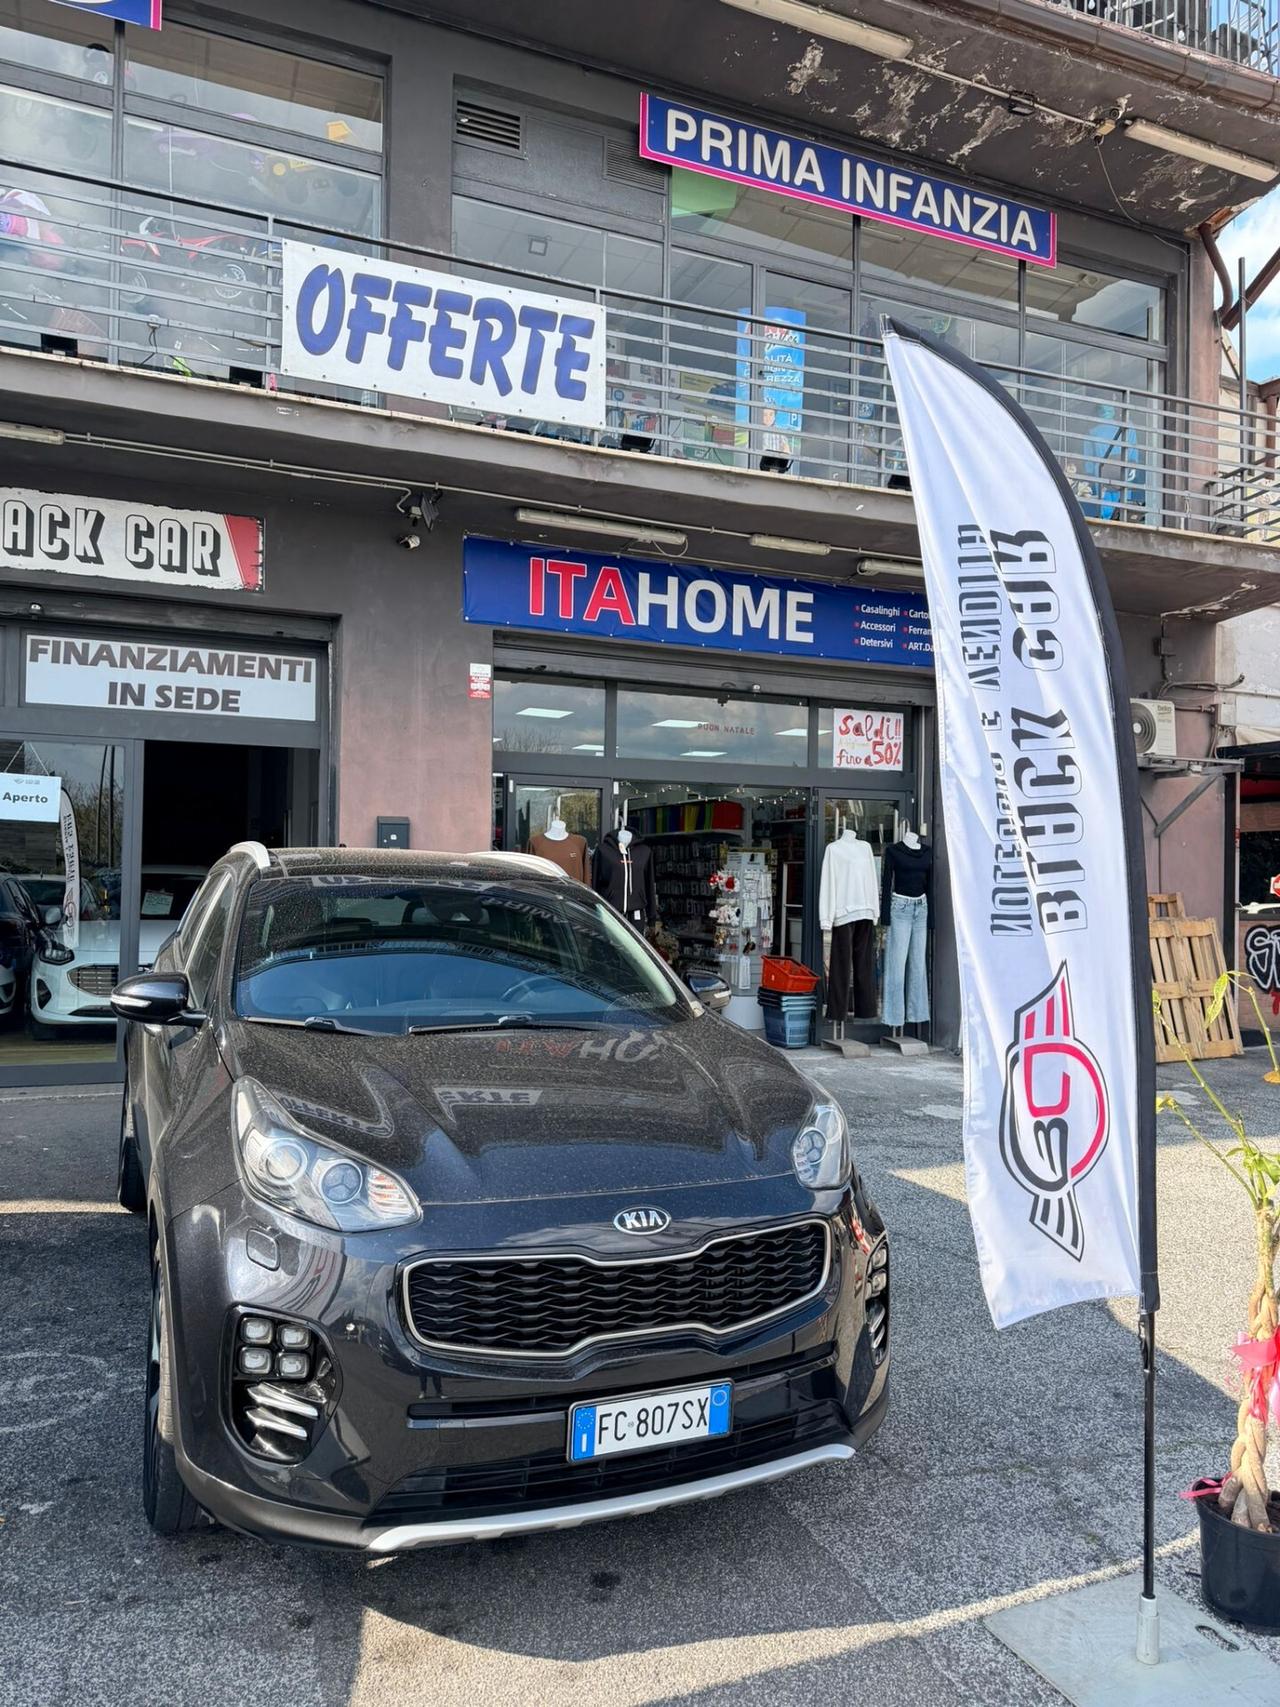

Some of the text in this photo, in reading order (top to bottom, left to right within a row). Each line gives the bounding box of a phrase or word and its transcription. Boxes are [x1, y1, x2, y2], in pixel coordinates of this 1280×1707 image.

[666, 108, 1038, 252] PRIMA INFANZIA
[296, 263, 596, 402] OFFERTE
[125, 513, 221, 577] CAR
[529, 556, 815, 643] ITAHOME
[860, 604, 900, 617] Casalinghi
[860, 620, 896, 633] Accessori
[908, 609, 930, 619] Carto
[860, 637, 894, 648] Detersivi
[28, 638, 313, 683] FINANZIAMENTI
[107, 681, 241, 713] IN SEDE
[724, 726, 755, 735] NATALE
[836, 749, 862, 767] fino
[871, 740, 902, 766] 50%
[2, 791, 49, 803] Aperto
[622, 1210, 664, 1229] KIA
[598, 1411, 628, 1445] FC
[636, 1397, 709, 1437] 807SX
